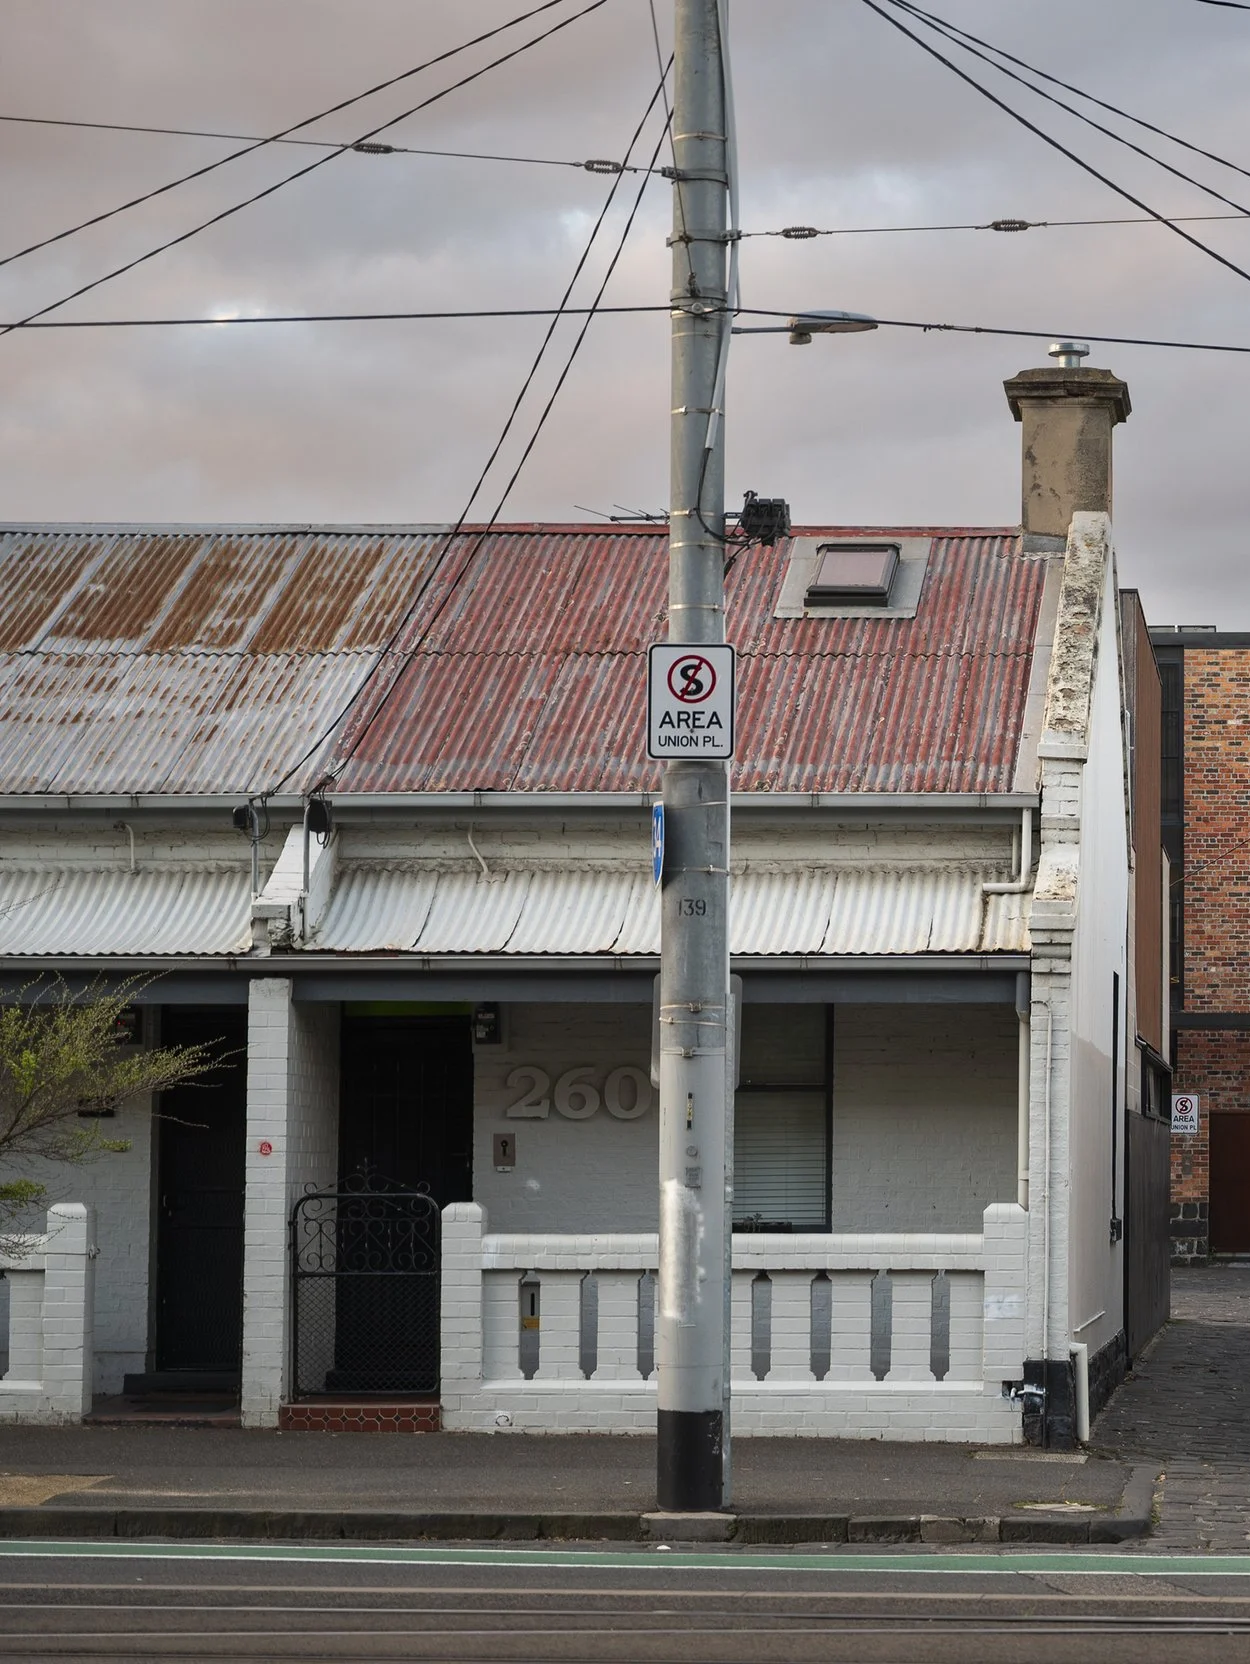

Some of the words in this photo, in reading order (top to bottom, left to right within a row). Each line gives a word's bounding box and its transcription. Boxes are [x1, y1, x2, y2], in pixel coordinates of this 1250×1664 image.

[659, 711, 723, 729] AREA
[658, 735, 699, 748] UNION
[702, 736, 724, 748] PL.
[678, 899, 707, 917] 139
[506, 1065, 652, 1121] 260
